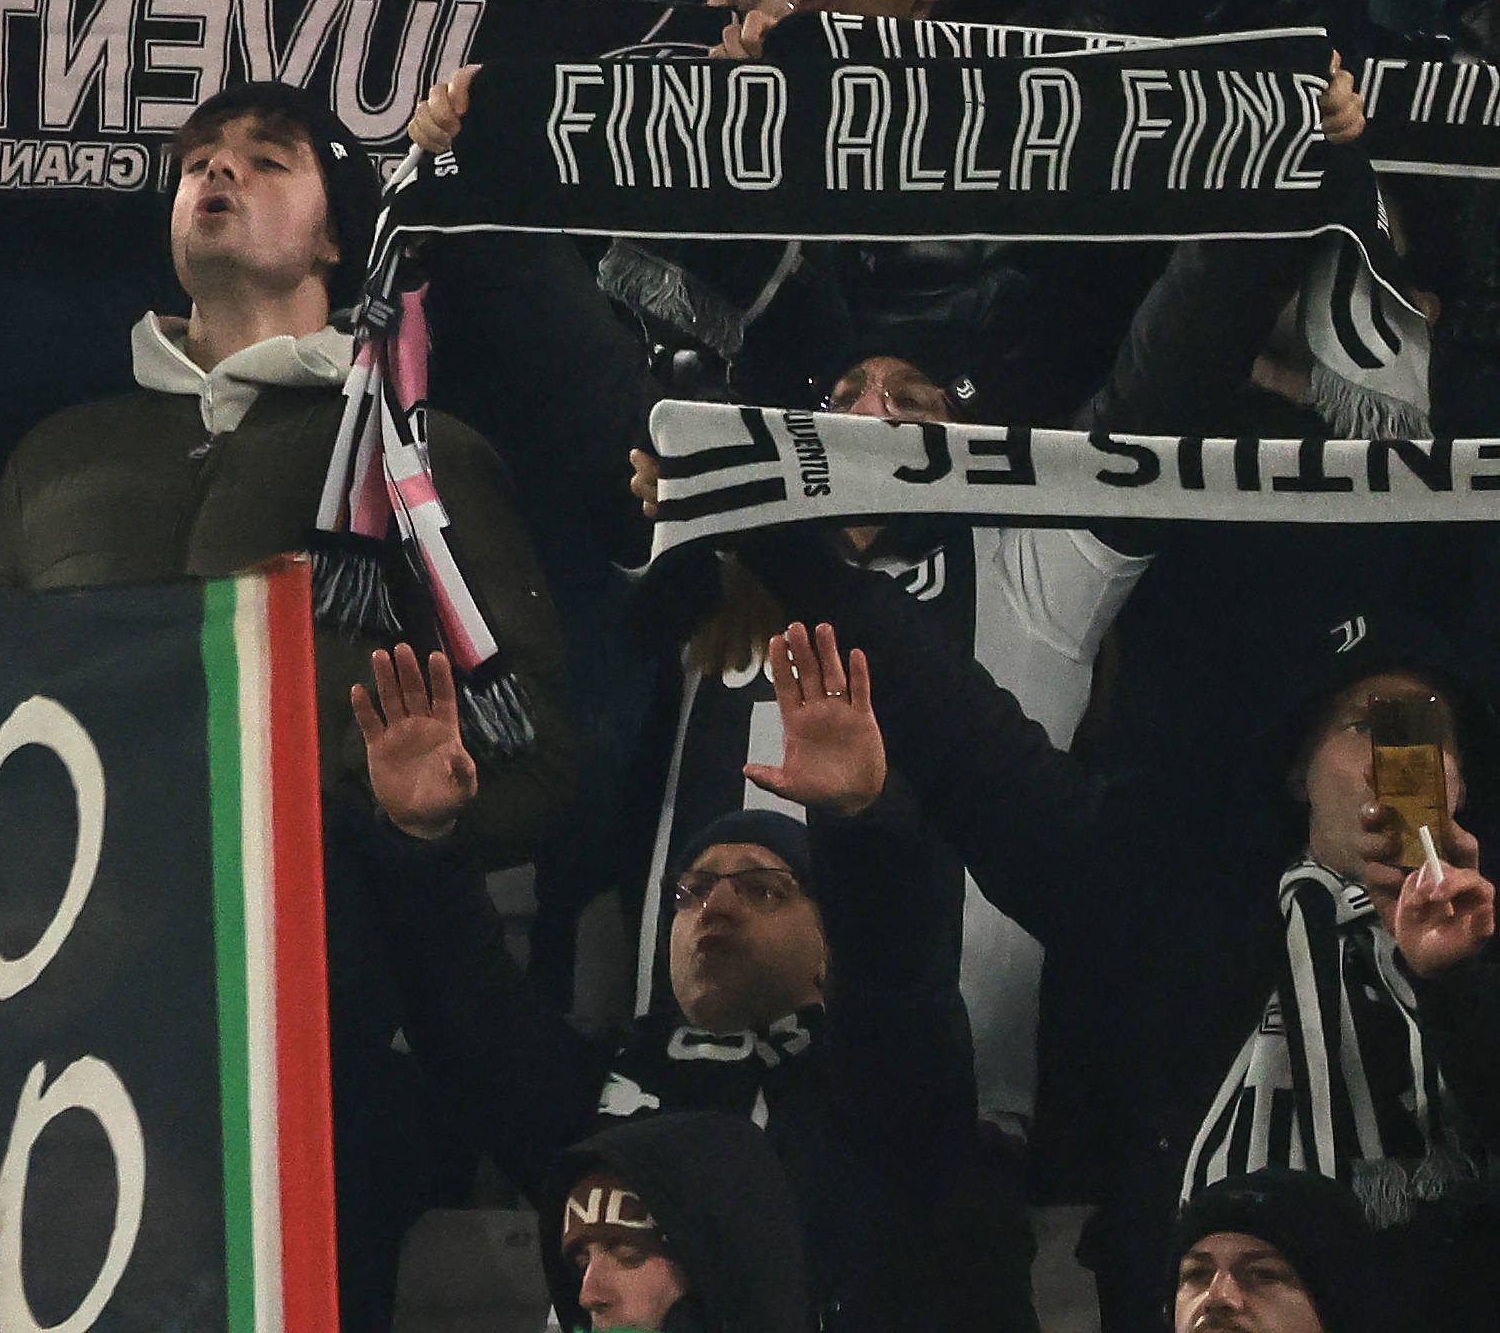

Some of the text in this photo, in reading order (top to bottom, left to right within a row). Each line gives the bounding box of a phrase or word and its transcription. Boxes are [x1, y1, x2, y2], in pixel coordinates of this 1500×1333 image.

[547, 61, 1329, 192] FINO ALLA FINE
